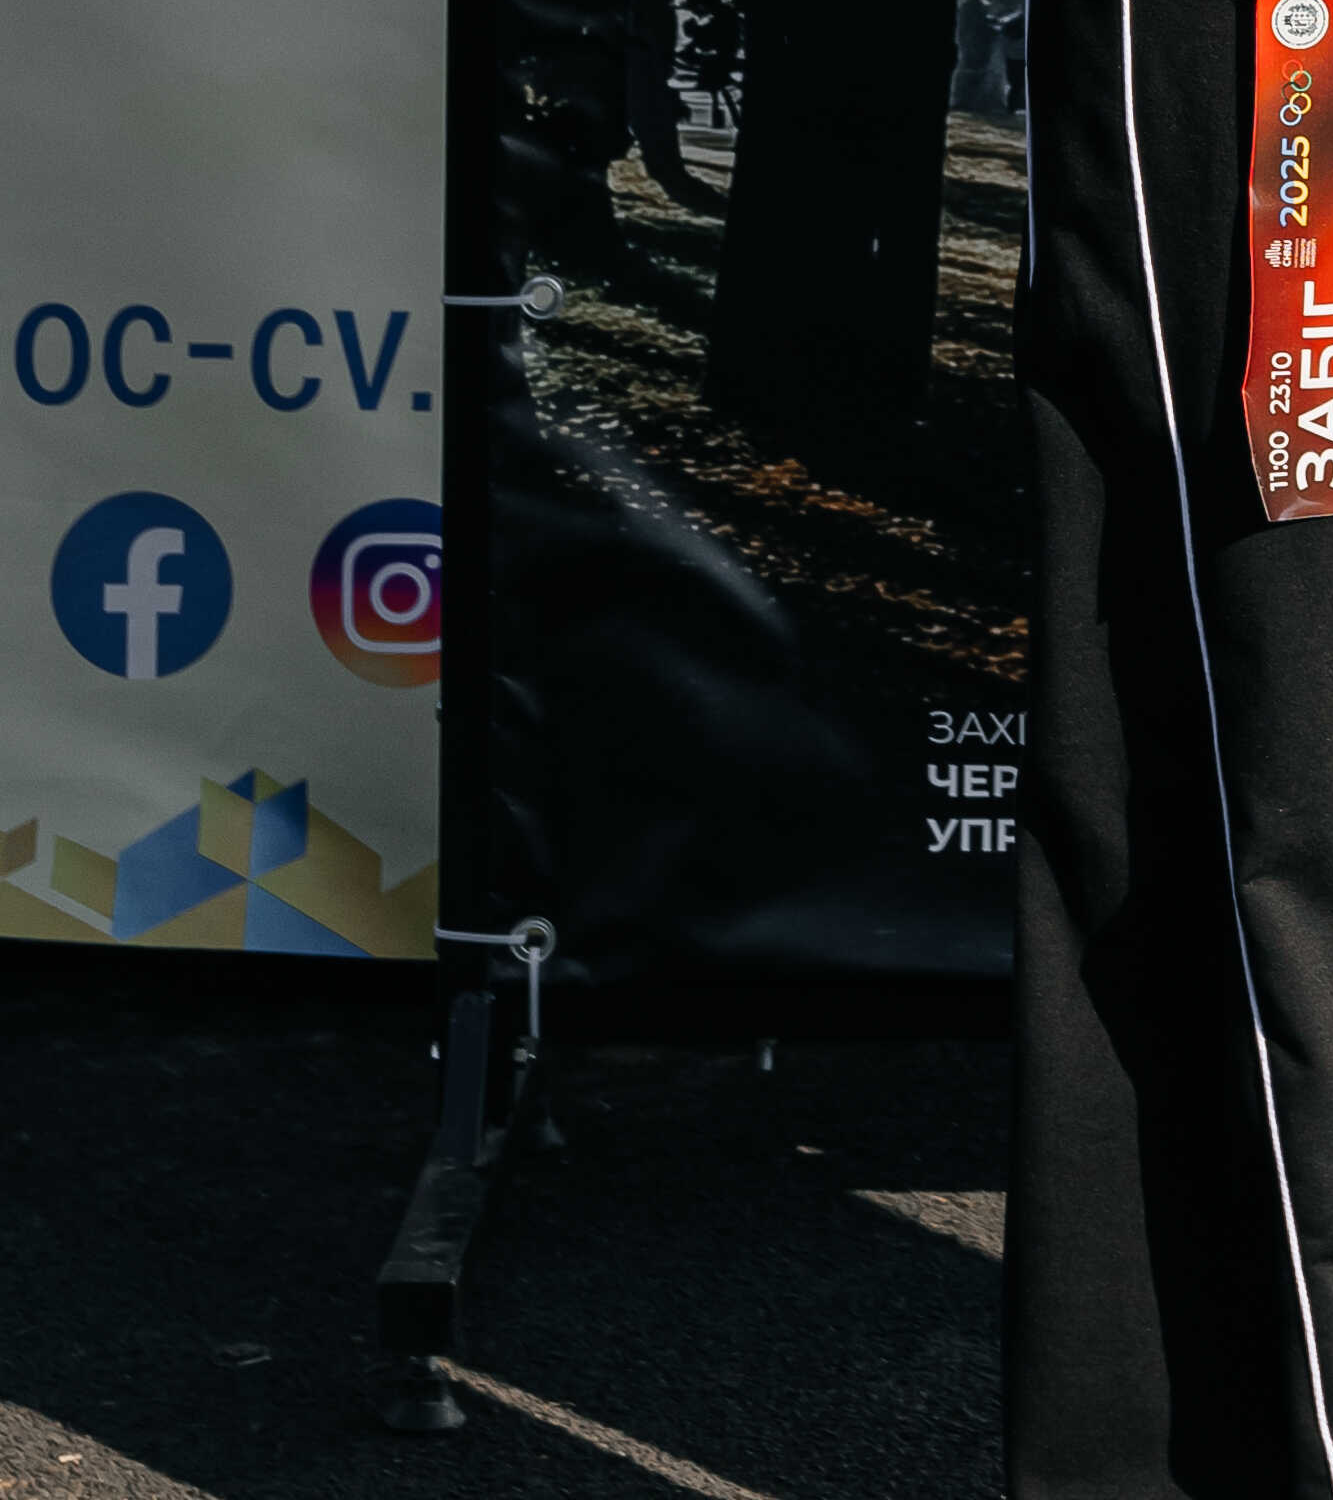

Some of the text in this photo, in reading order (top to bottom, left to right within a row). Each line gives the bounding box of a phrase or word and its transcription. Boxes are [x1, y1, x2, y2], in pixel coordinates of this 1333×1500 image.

[1280, 136, 1310, 227] 2025
[1269, 351, 1293, 492] 11:00 23.10
